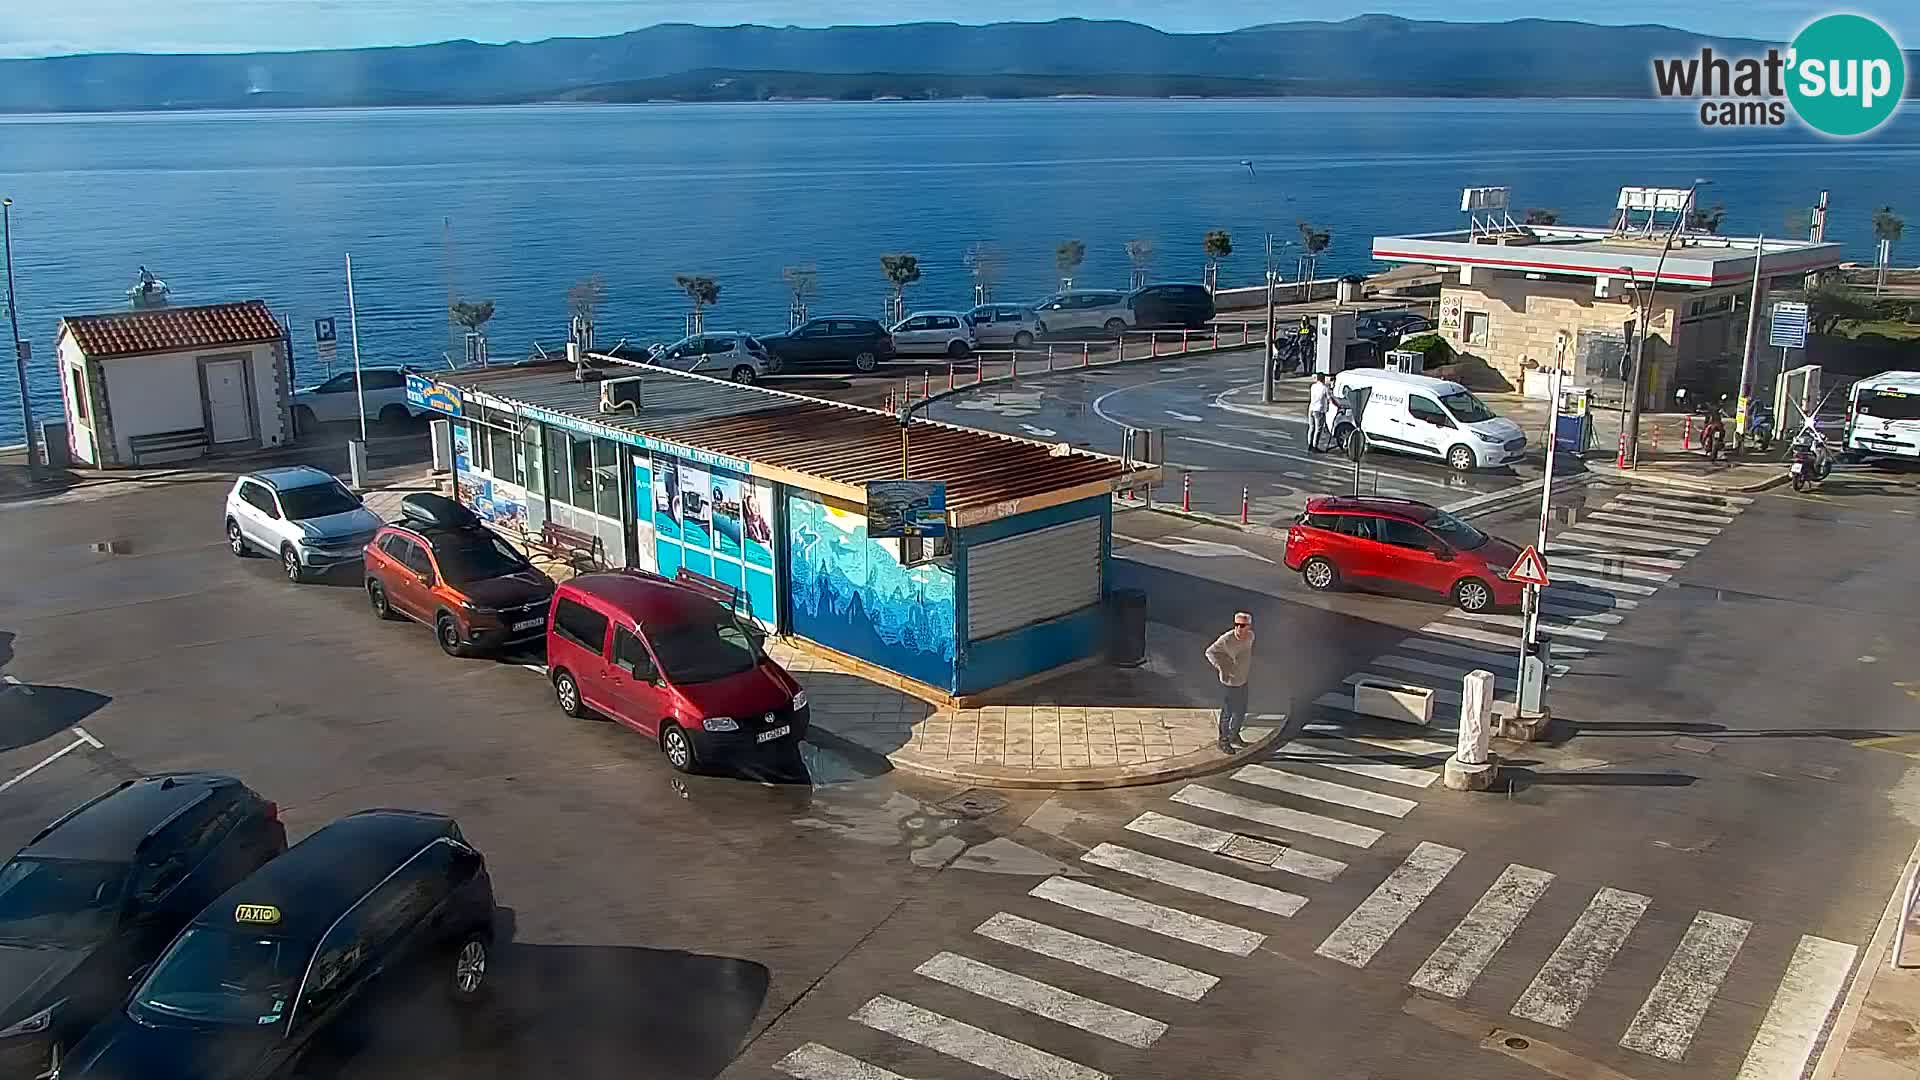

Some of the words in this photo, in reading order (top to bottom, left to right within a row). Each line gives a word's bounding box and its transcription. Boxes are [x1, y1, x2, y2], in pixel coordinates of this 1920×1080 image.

[319, 320, 331, 338] P
[694, 450, 718, 464] TICKET
[719, 456, 747, 473] OFFICE
[239, 907, 264, 920] TAXI
